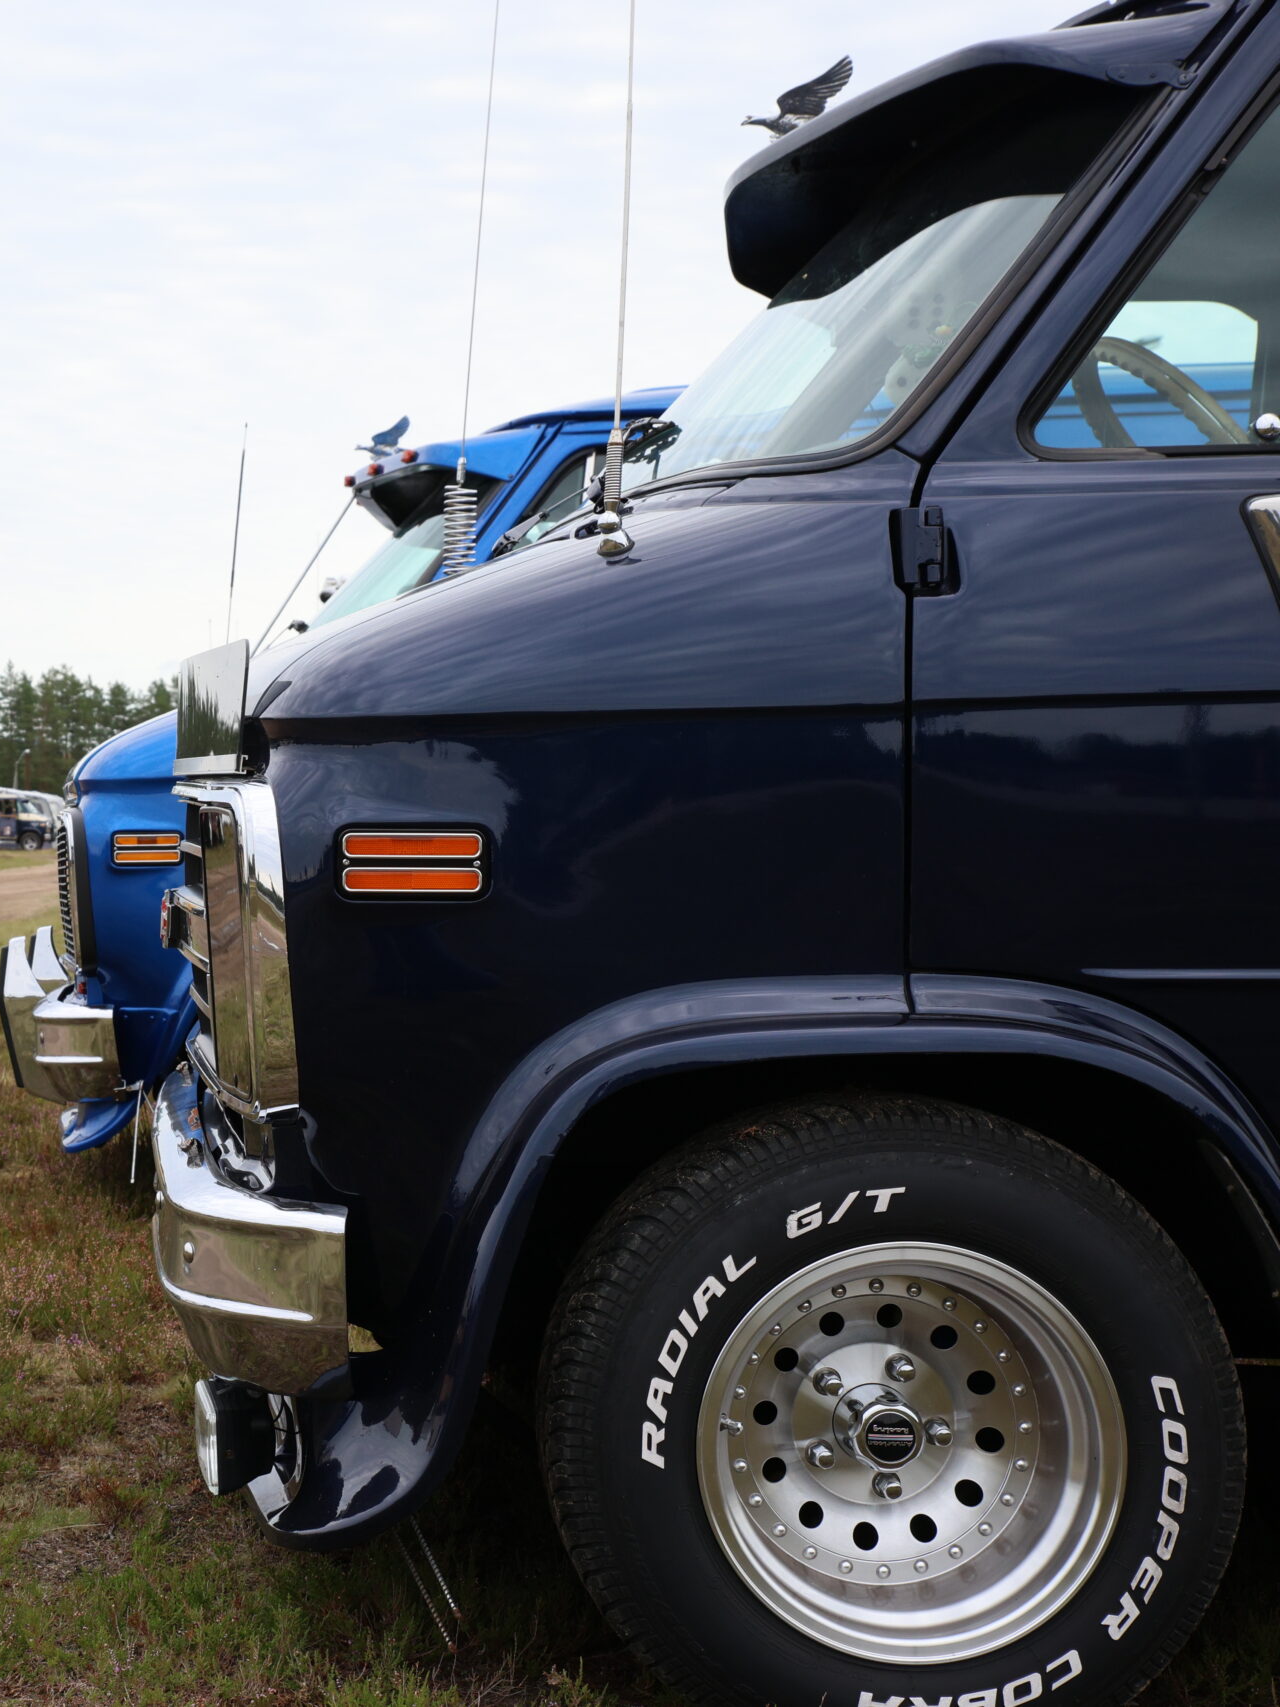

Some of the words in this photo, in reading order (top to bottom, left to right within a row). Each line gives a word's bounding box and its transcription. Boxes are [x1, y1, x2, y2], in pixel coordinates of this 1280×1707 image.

[642, 1254, 757, 1469] RADIAL
[786, 1187, 906, 1239] G/T
[1100, 1375, 1189, 1641] COOPER
